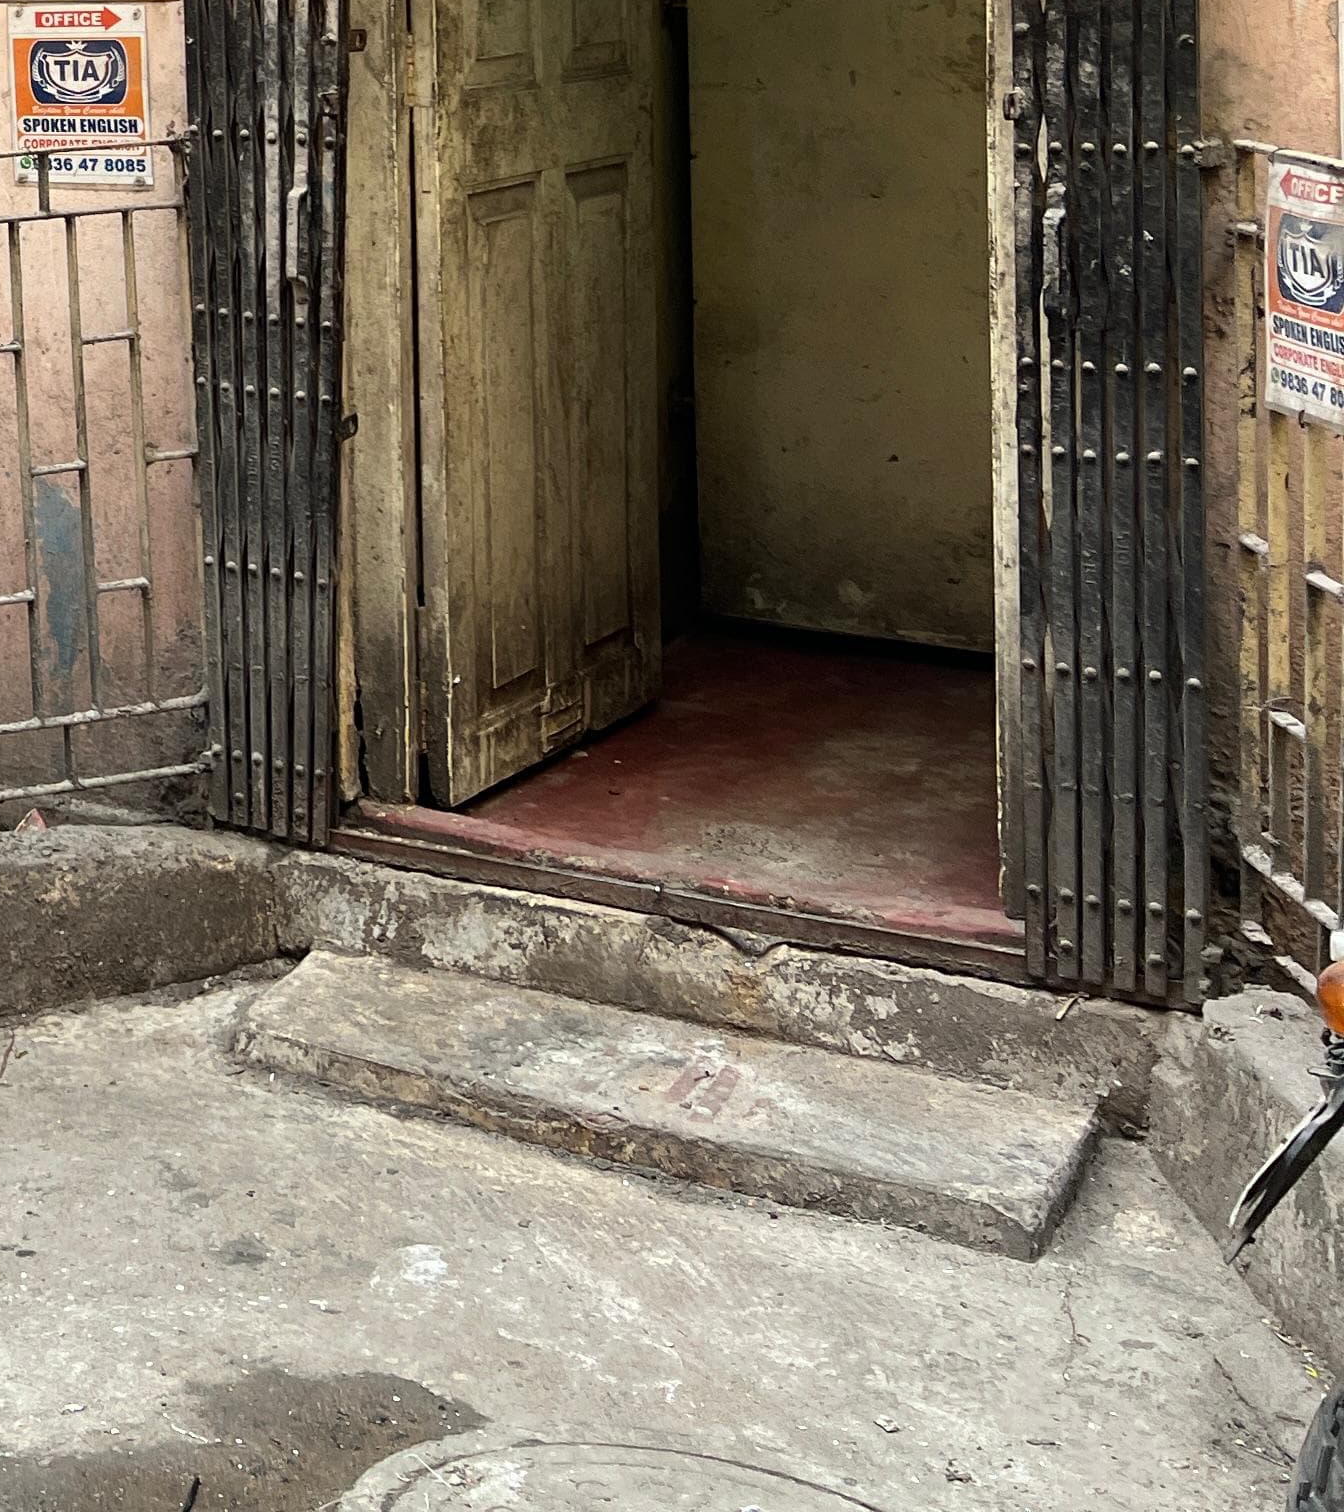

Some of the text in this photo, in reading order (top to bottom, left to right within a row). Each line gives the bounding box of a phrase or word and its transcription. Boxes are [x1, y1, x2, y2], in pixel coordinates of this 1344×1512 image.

[41, 14, 102, 27] OFFICE
[54, 60, 100, 82] TIA
[23, 118, 138, 133] SPOKEN ENGLISH
[79, 159, 146, 172] 47 8085
